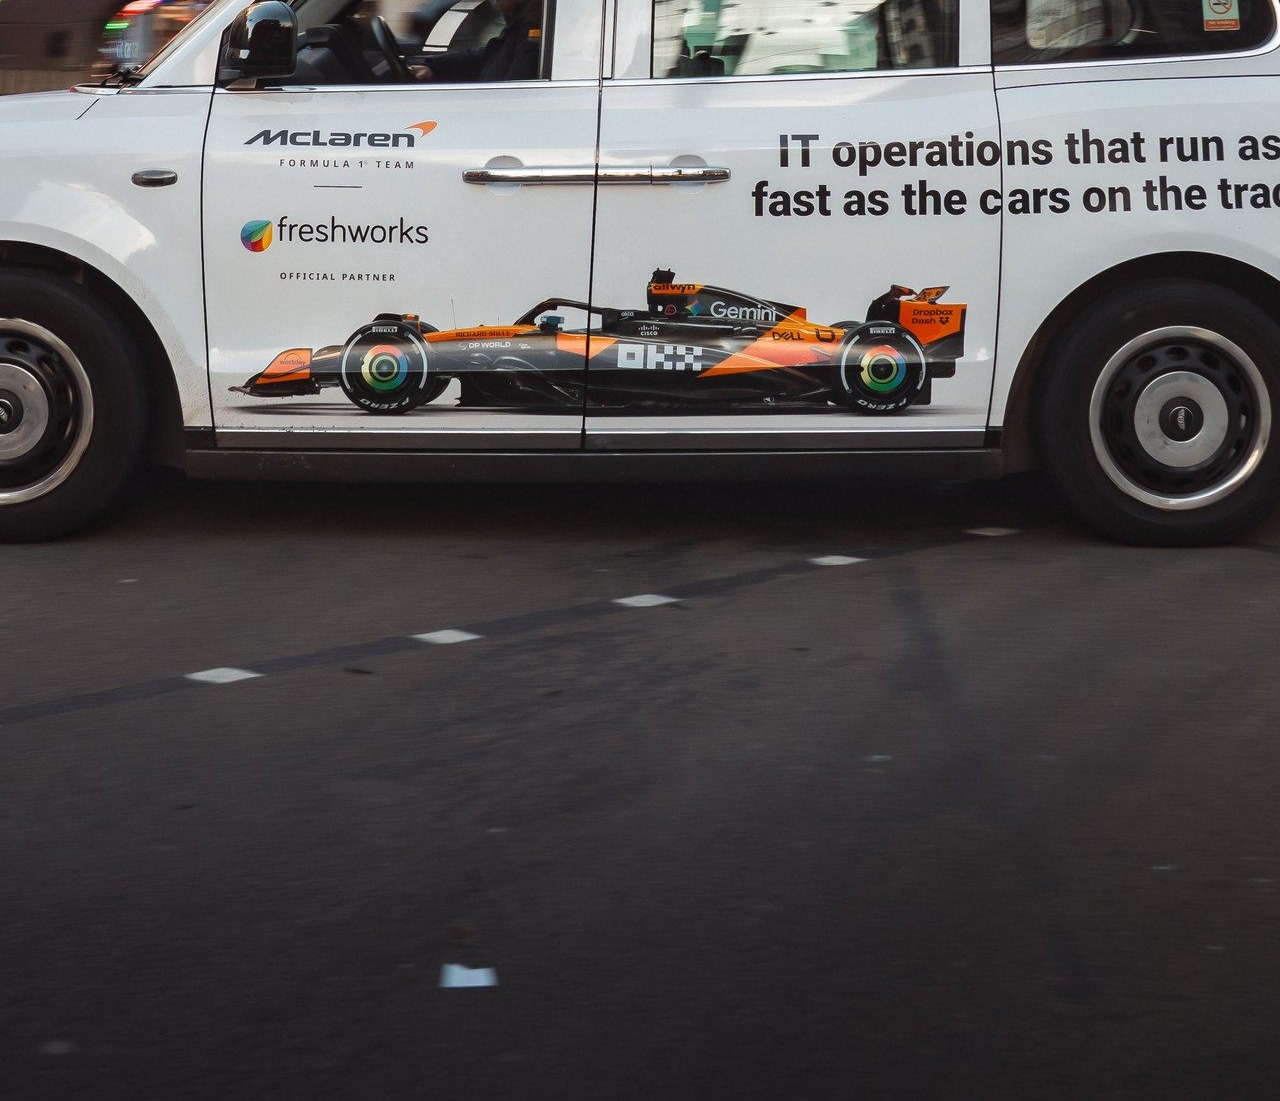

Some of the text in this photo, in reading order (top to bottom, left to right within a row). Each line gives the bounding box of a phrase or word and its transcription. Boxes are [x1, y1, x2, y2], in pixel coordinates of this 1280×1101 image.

[243, 129, 415, 148] McLaren
[779, 133, 819, 168] IT
[831, 130, 1052, 176] operations
[1065, 129, 1146, 165] that
[1159, 134, 1224, 162] run
[279, 158, 350, 168] FORMULA
[376, 160, 415, 169] TEAM
[752, 181, 832, 216] fast
[842, 185, 889, 216] as
[901, 180, 967, 216] the
[979, 183, 1070, 215] cars
[1082, 184, 1132, 214] on
[1142, 175, 1207, 212] the
[277, 215, 429, 244] freshworks
[280, 272, 396, 282] OFFICIAL PARTNER
[710, 301, 776, 321] Gemini
[912, 308, 953, 317] Dropbox
[772, 331, 804, 341] DELL
[279, 358, 306, 366] workday
